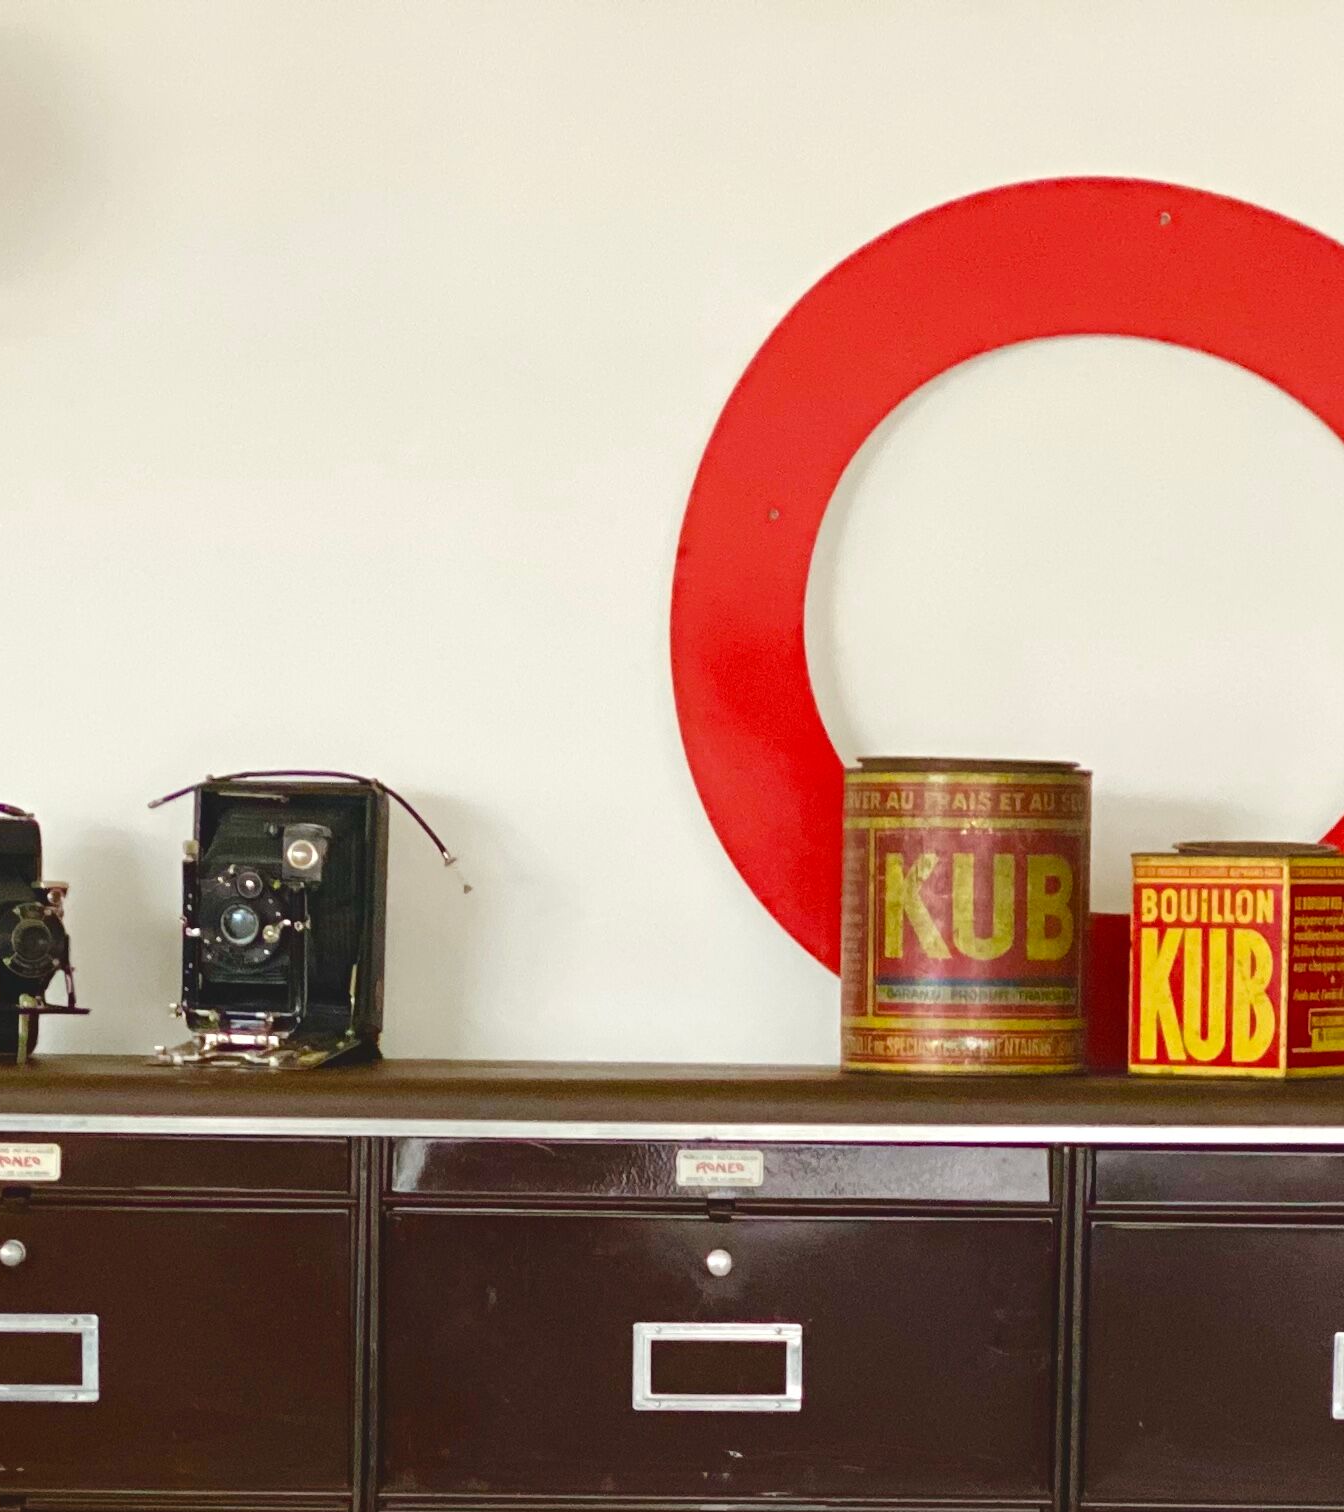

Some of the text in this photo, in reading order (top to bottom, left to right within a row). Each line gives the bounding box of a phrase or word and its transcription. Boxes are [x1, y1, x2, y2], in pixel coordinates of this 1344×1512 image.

[886, 791, 915, 810] AU
[999, 791, 1024, 811] ET
[884, 852, 1074, 961] KUB
[1139, 927, 1276, 1063] KUB
